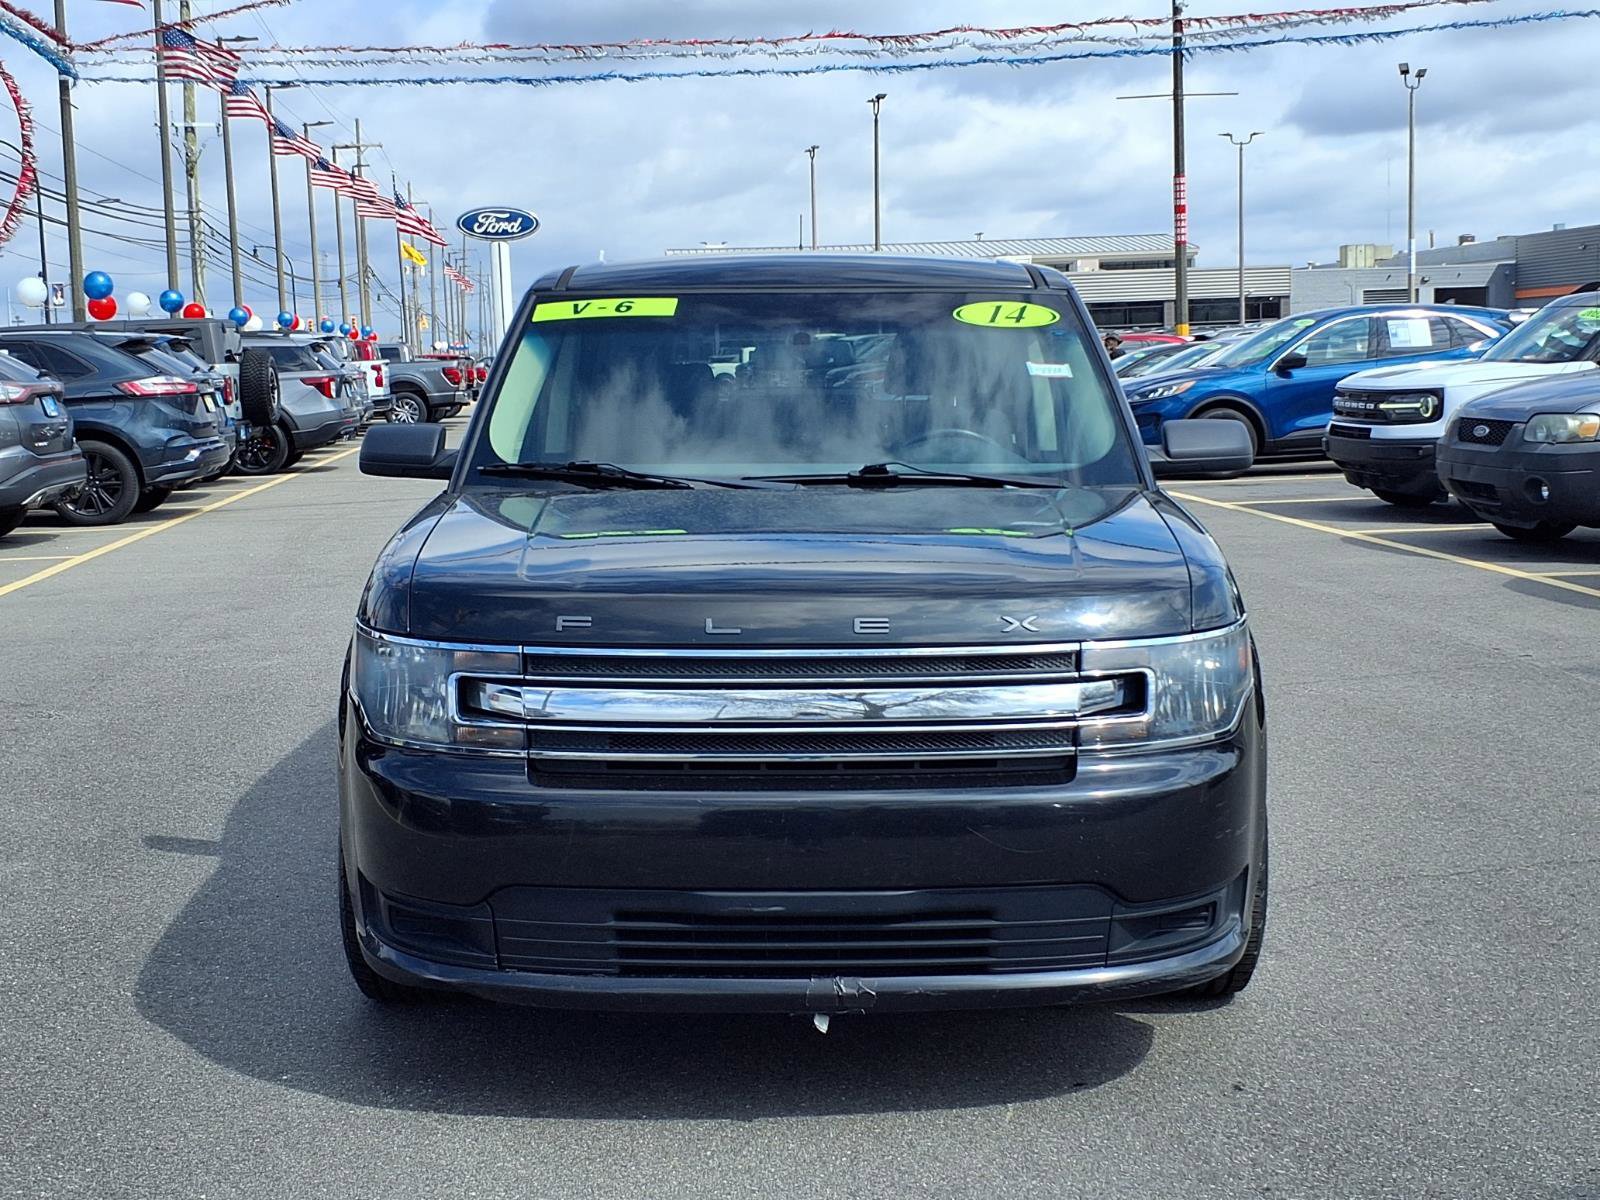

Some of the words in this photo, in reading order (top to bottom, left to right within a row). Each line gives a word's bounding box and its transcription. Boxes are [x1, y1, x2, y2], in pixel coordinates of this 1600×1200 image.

[473, 212, 523, 234] Ford
[989, 304, 1028, 324] 14
[556, 615, 1041, 634] FLEX
